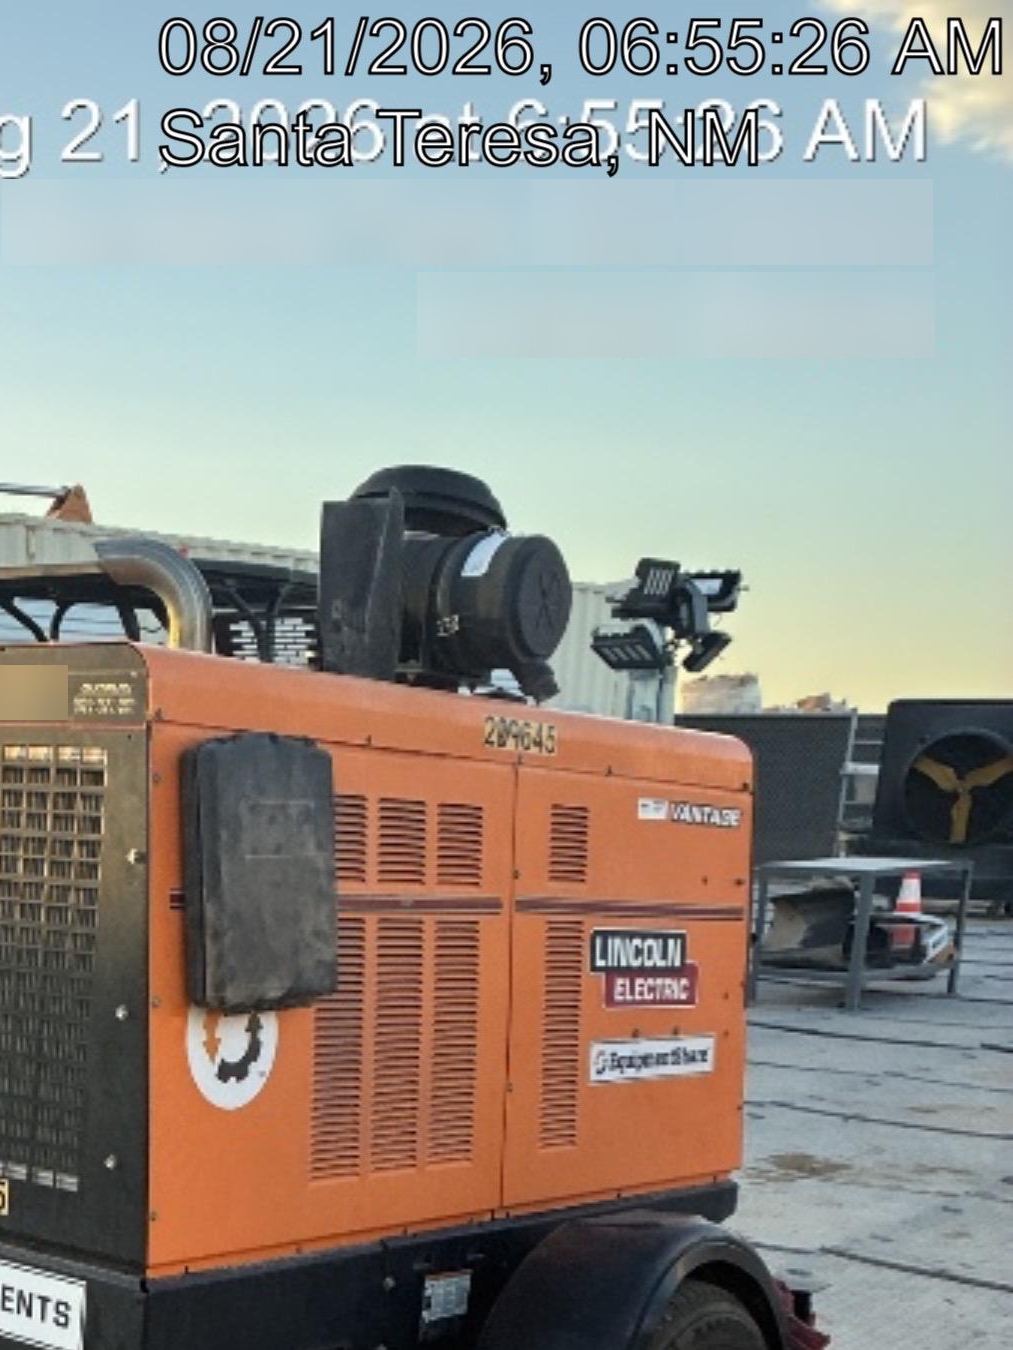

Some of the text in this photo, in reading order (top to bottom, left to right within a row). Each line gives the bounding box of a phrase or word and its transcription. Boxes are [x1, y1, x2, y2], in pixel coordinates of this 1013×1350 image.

[484, 716, 557, 754] 209645
[594, 935, 682, 969] LINCOLN
[613, 975, 689, 1002] ELECTRIC
